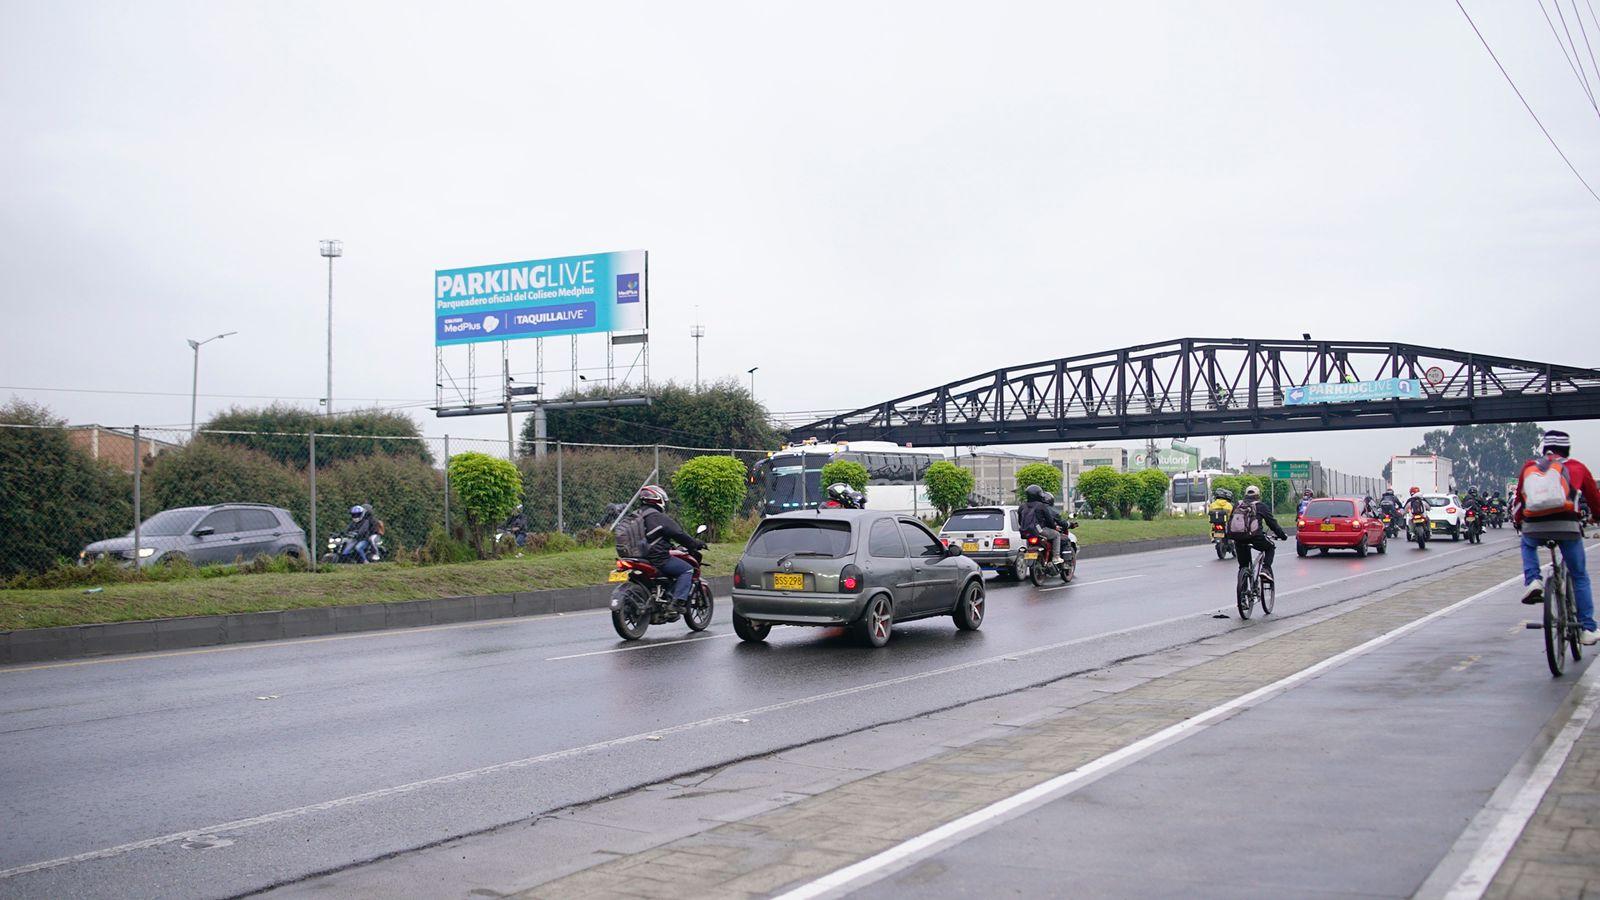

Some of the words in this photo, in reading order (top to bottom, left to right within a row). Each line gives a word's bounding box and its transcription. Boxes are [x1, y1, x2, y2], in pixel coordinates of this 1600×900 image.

[437, 260, 594, 298] PARKINGLIVE
[437, 298, 488, 310] Parqueadero
[488, 293, 513, 304] oficial
[514, 291, 527, 302] del
[528, 289, 557, 300] Coliseo
[558, 286, 594, 297] Medplus
[444, 322, 482, 333] MedPlus
[1309, 381, 1393, 395] PARKINGLIVE
